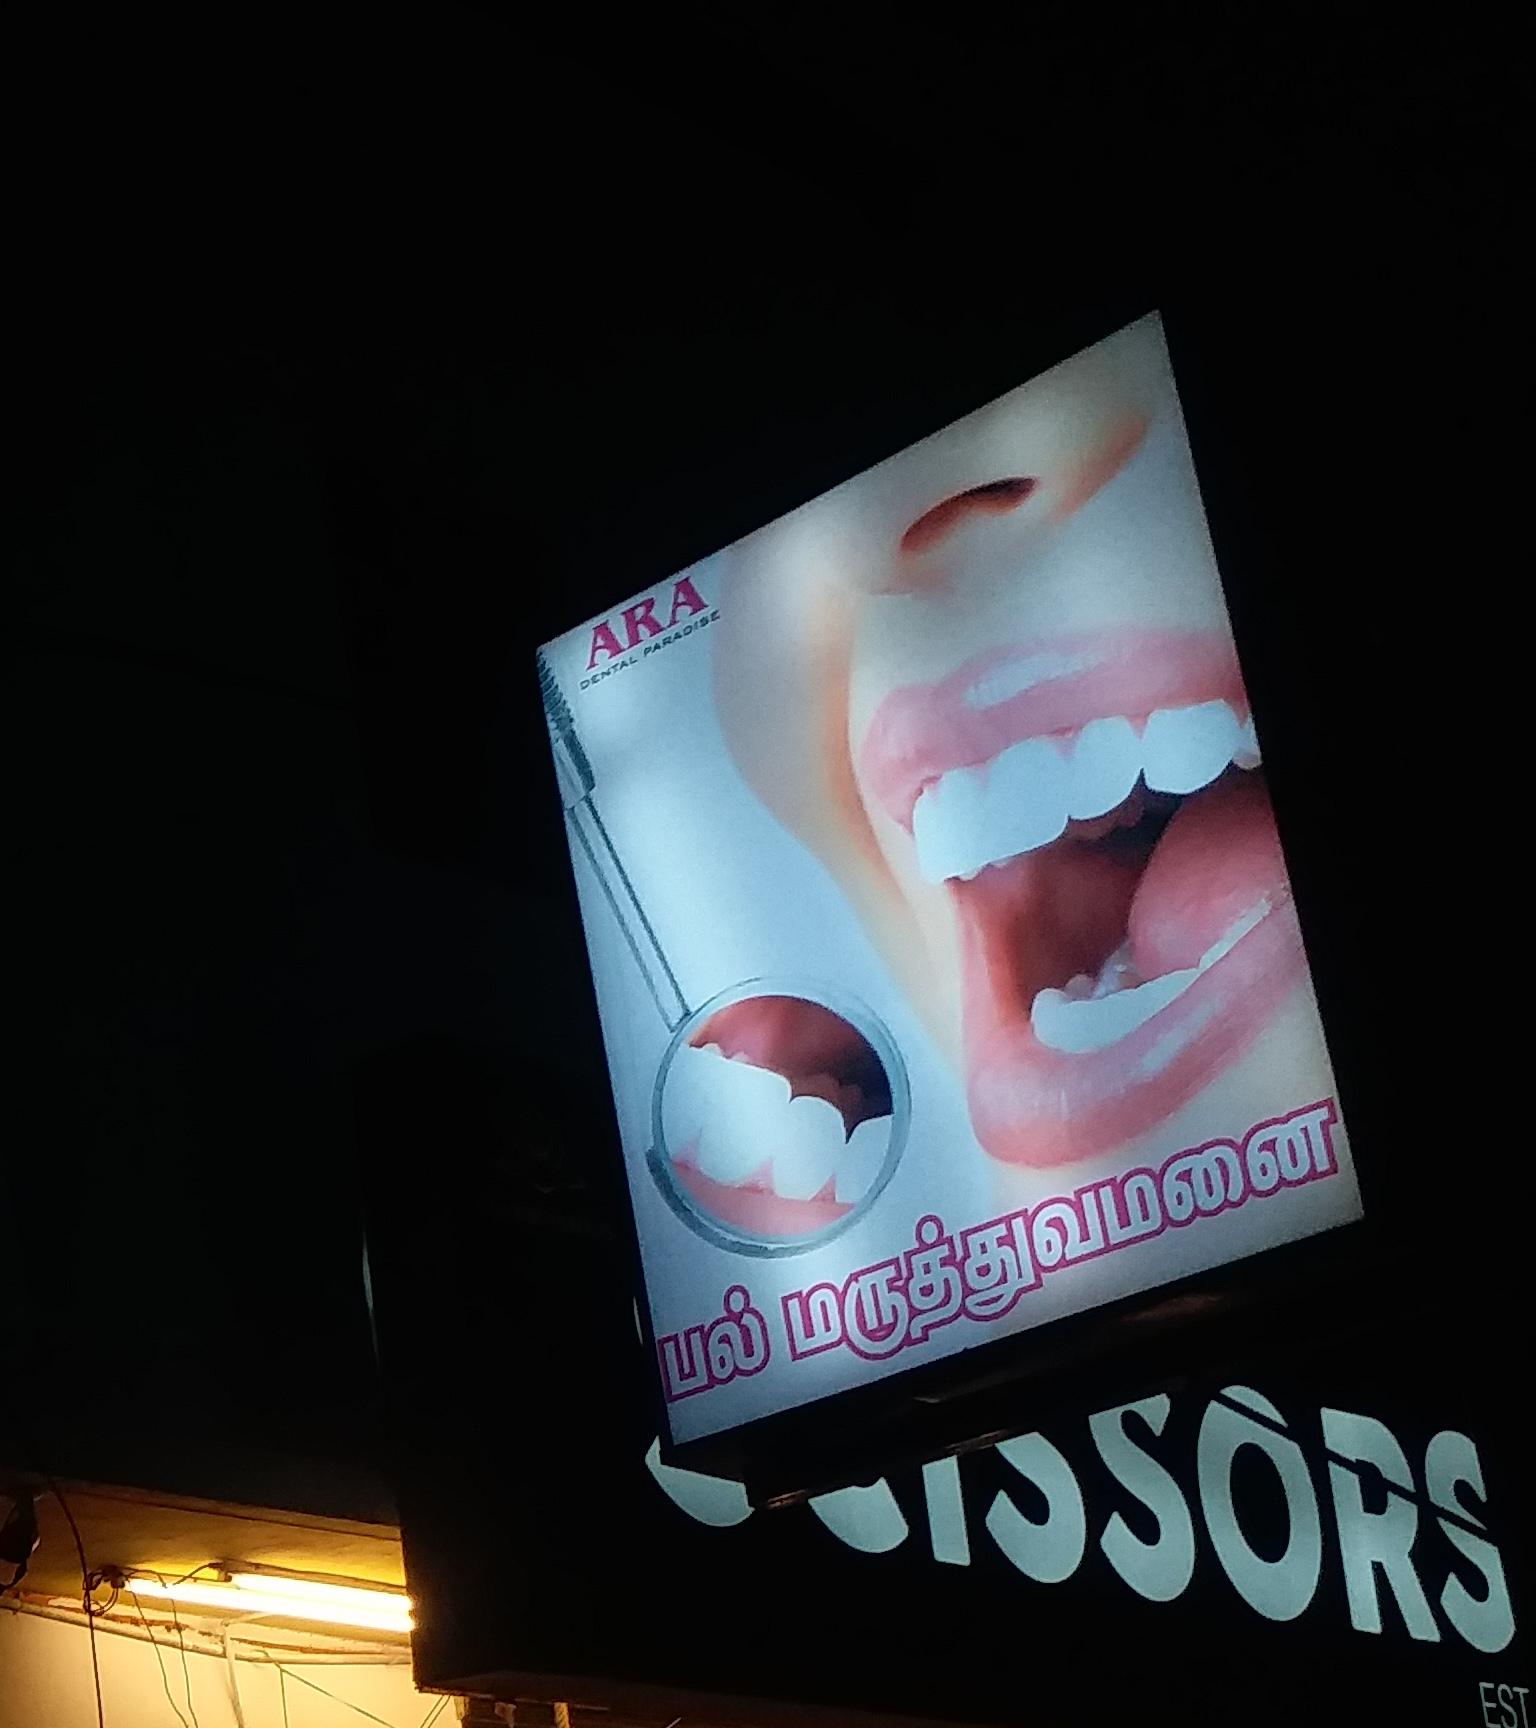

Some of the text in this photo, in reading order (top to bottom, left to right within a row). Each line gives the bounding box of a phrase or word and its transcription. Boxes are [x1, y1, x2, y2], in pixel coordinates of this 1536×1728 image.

[580, 609, 720, 690] DENTAL PARADISE
[587, 577, 708, 670] ARA
[658, 1098, 1338, 1402] பல் மருத்துவமனை
